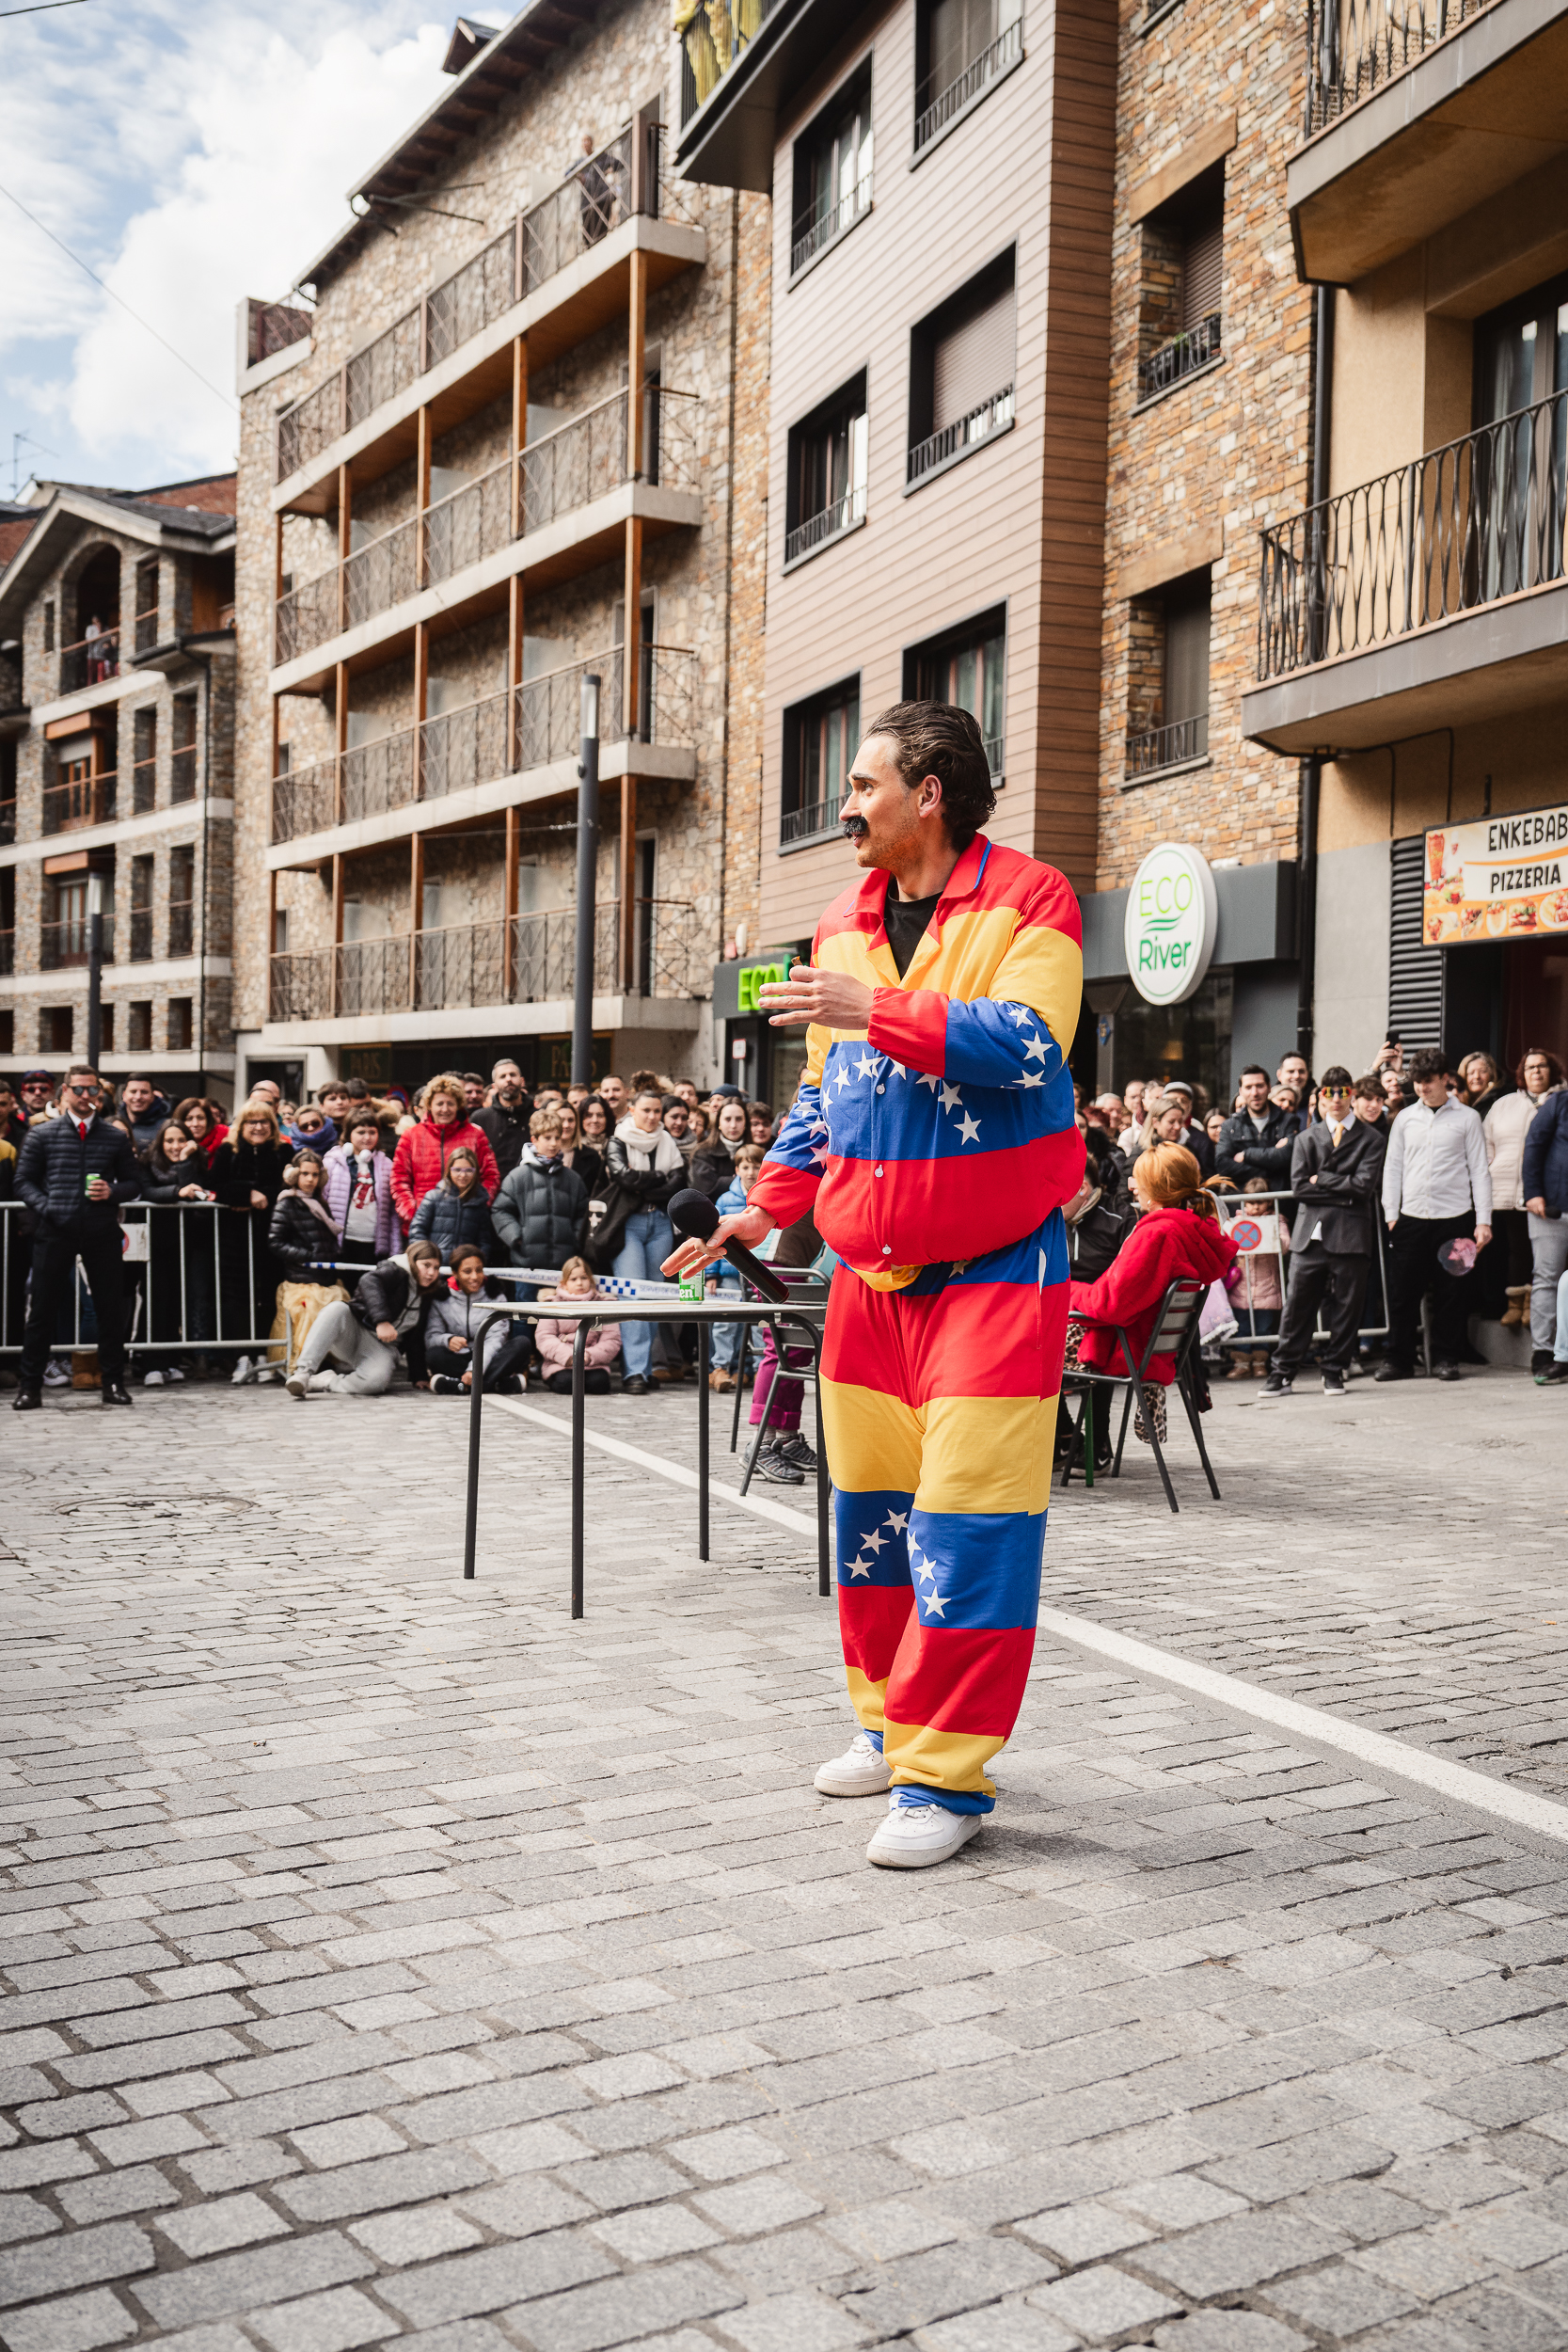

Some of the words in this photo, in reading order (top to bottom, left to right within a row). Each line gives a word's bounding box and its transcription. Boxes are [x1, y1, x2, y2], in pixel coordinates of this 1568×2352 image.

[1488, 813, 1568, 851] ENKEBAB
[1139, 873, 1193, 916] ECO
[1490, 865, 1561, 893] PIZZERIA
[1138, 935, 1192, 972] River
